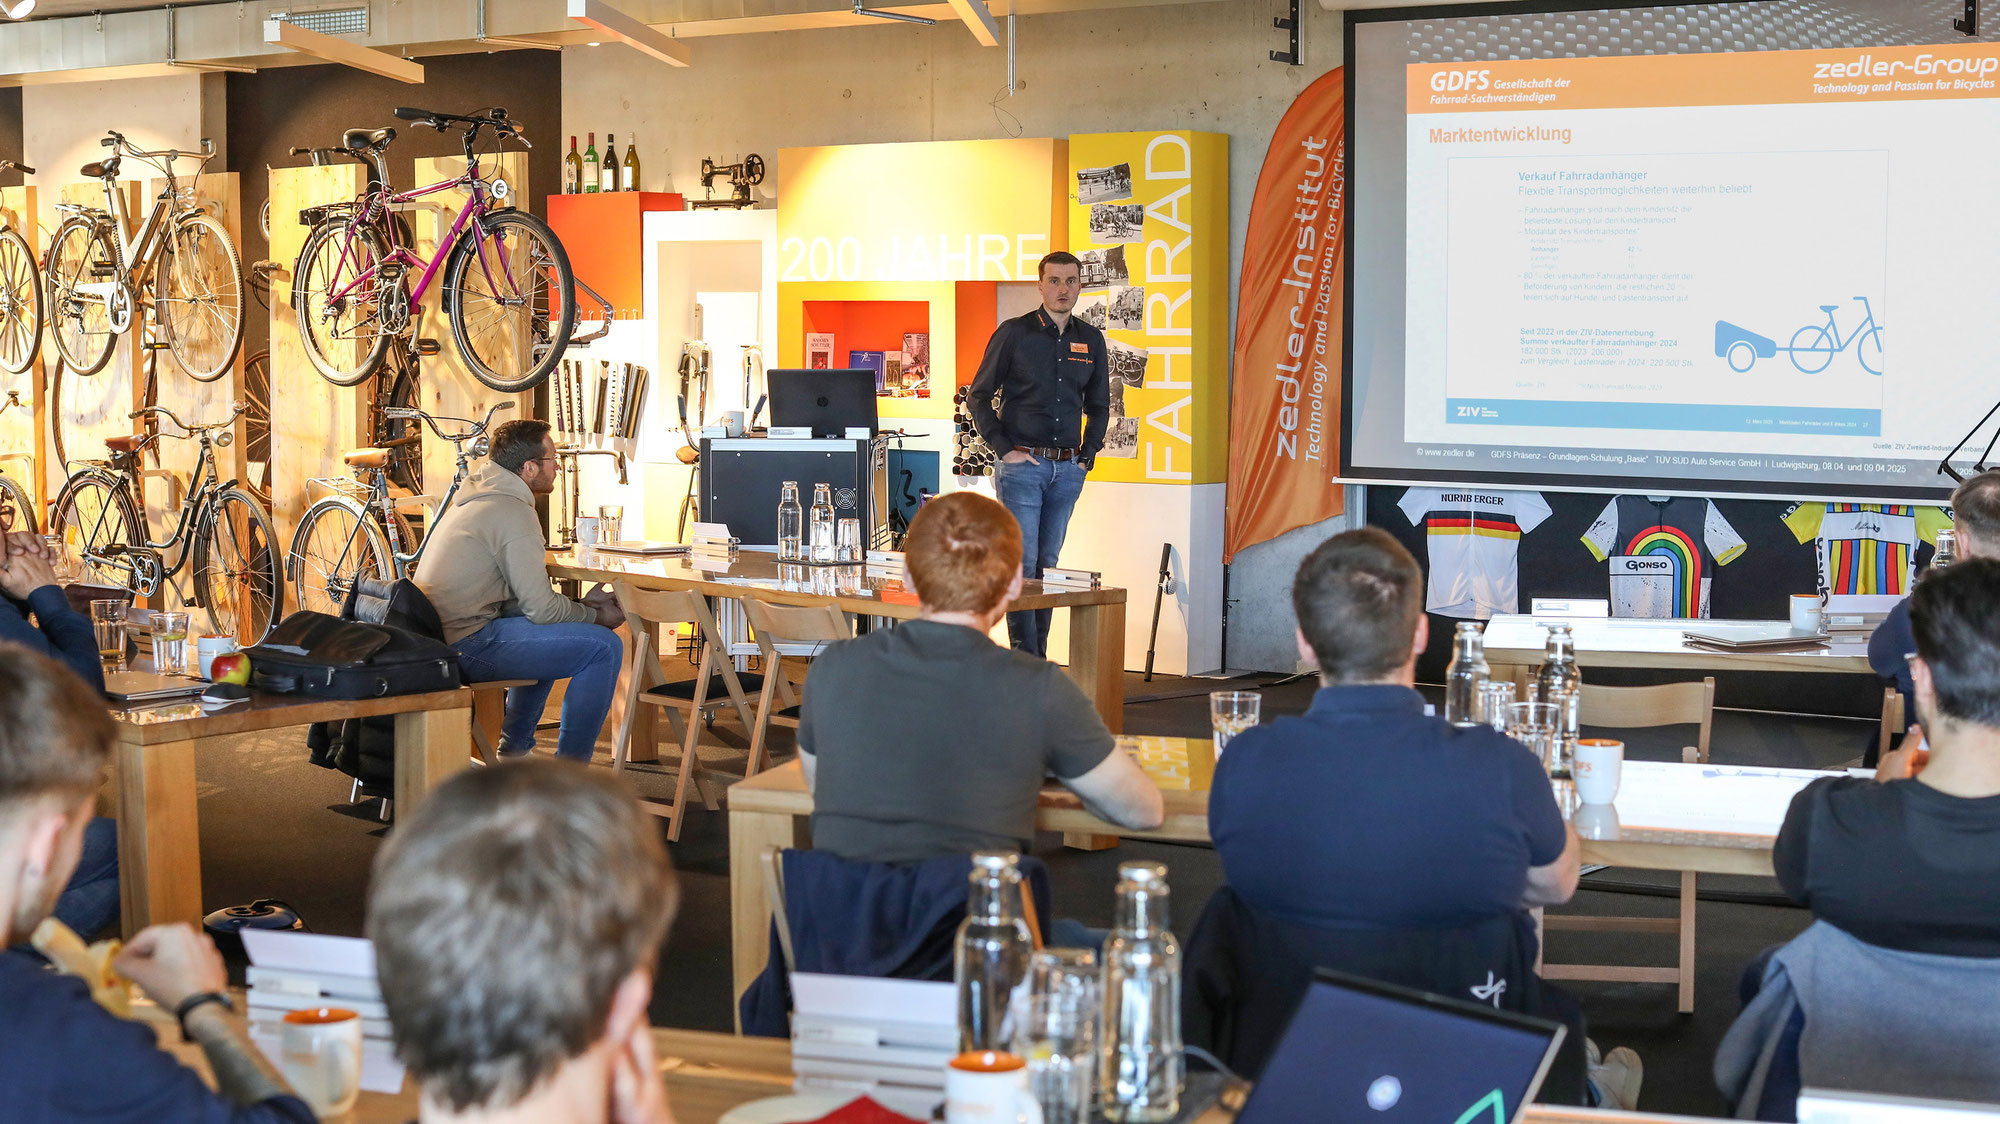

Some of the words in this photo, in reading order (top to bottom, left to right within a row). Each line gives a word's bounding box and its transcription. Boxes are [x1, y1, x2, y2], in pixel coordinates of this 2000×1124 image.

[1813, 54, 1999, 78] zedler-Group
[1430, 70, 1490, 92] GDFS
[1494, 78, 1552, 90] Gesellschaft
[1554, 77, 1571, 89] der
[1813, 82, 1870, 95] Technology
[1872, 81, 1892, 92] and
[1894, 79, 1934, 91] Passion
[1935, 79, 1952, 90] for
[1954, 78, 1995, 91] Bicycles
[1430, 92, 1556, 105] Fahrrad-Sachverständigen
[1429, 126, 1572, 145] Marktentwicklung
[1518, 171, 1556, 181] Verkauf
[1559, 170, 1648, 183] Fahrradanhänger
[1518, 186, 1554, 196] Flexible
[1671, 184, 1717, 194] weiterhin
[1719, 183, 1753, 194] beliebt
[1323, 213, 1337, 245] for
[781, 235, 862, 282] 200
[877, 234, 1047, 282] JAHRE
[1315, 246, 1334, 314] Passion
[1144, 134, 1192, 480] FAHRRAD
[1276, 136, 1327, 460] zedler-Institut
[1313, 320, 1328, 355] and
[1520, 328, 1535, 336] Seit
[1536, 328, 1554, 336] 2022
[1556, 328, 1564, 336] in
[1565, 328, 1578, 336] der
[1551, 338, 1589, 346] verkaufter
[1659, 339, 1678, 347] 2024
[1305, 360, 1328, 461] Technology
[1457, 406, 1480, 417] ZIV
[1491, 450, 1512, 459] GDFS
[1690, 456, 1707, 465] Auto
[1709, 457, 1736, 467] Service
[1738, 458, 1761, 468] GmbH
[1847, 463, 1862, 472] und
